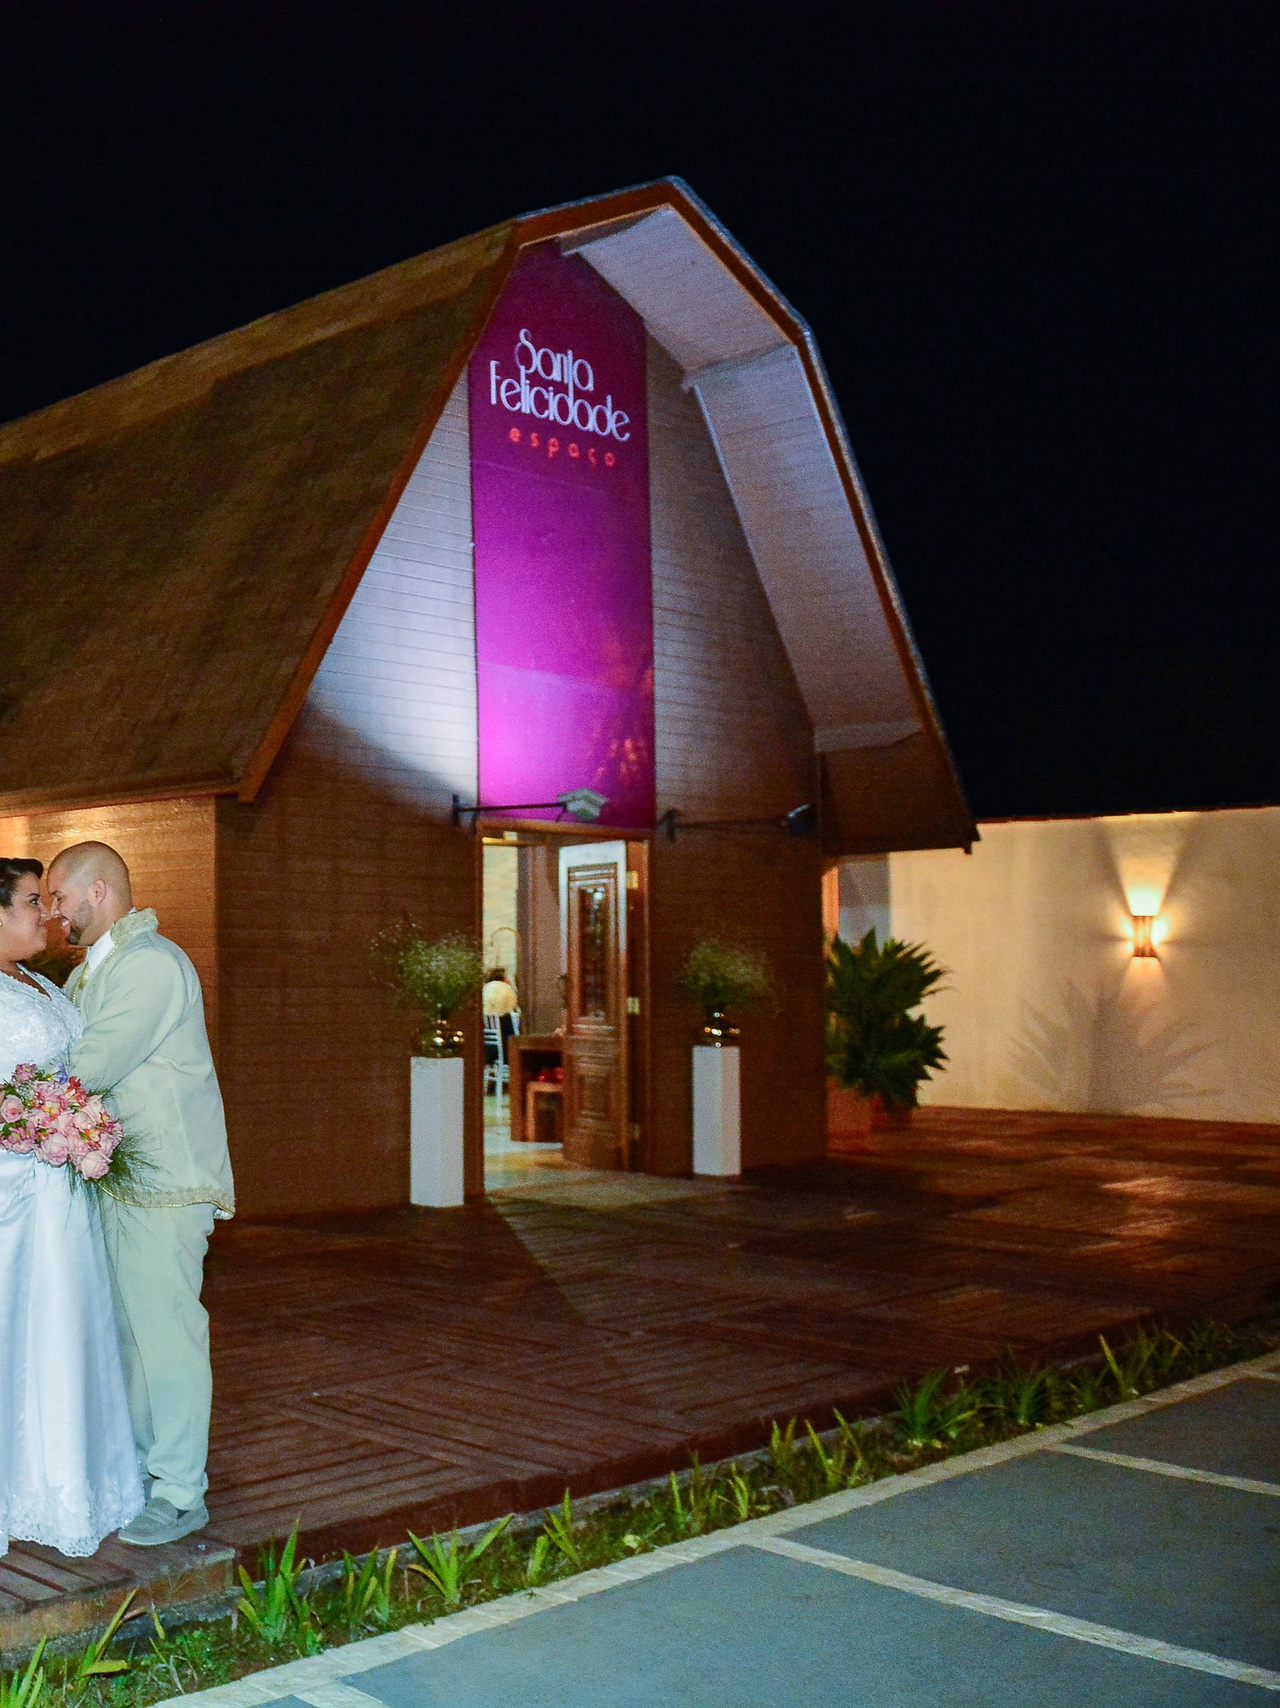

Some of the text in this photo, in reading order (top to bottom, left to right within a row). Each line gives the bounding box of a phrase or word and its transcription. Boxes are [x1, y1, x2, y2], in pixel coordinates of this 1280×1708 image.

[514, 328, 594, 392] Santa
[489, 359, 631, 442] Felicidade
[509, 426, 616, 468] espaço
